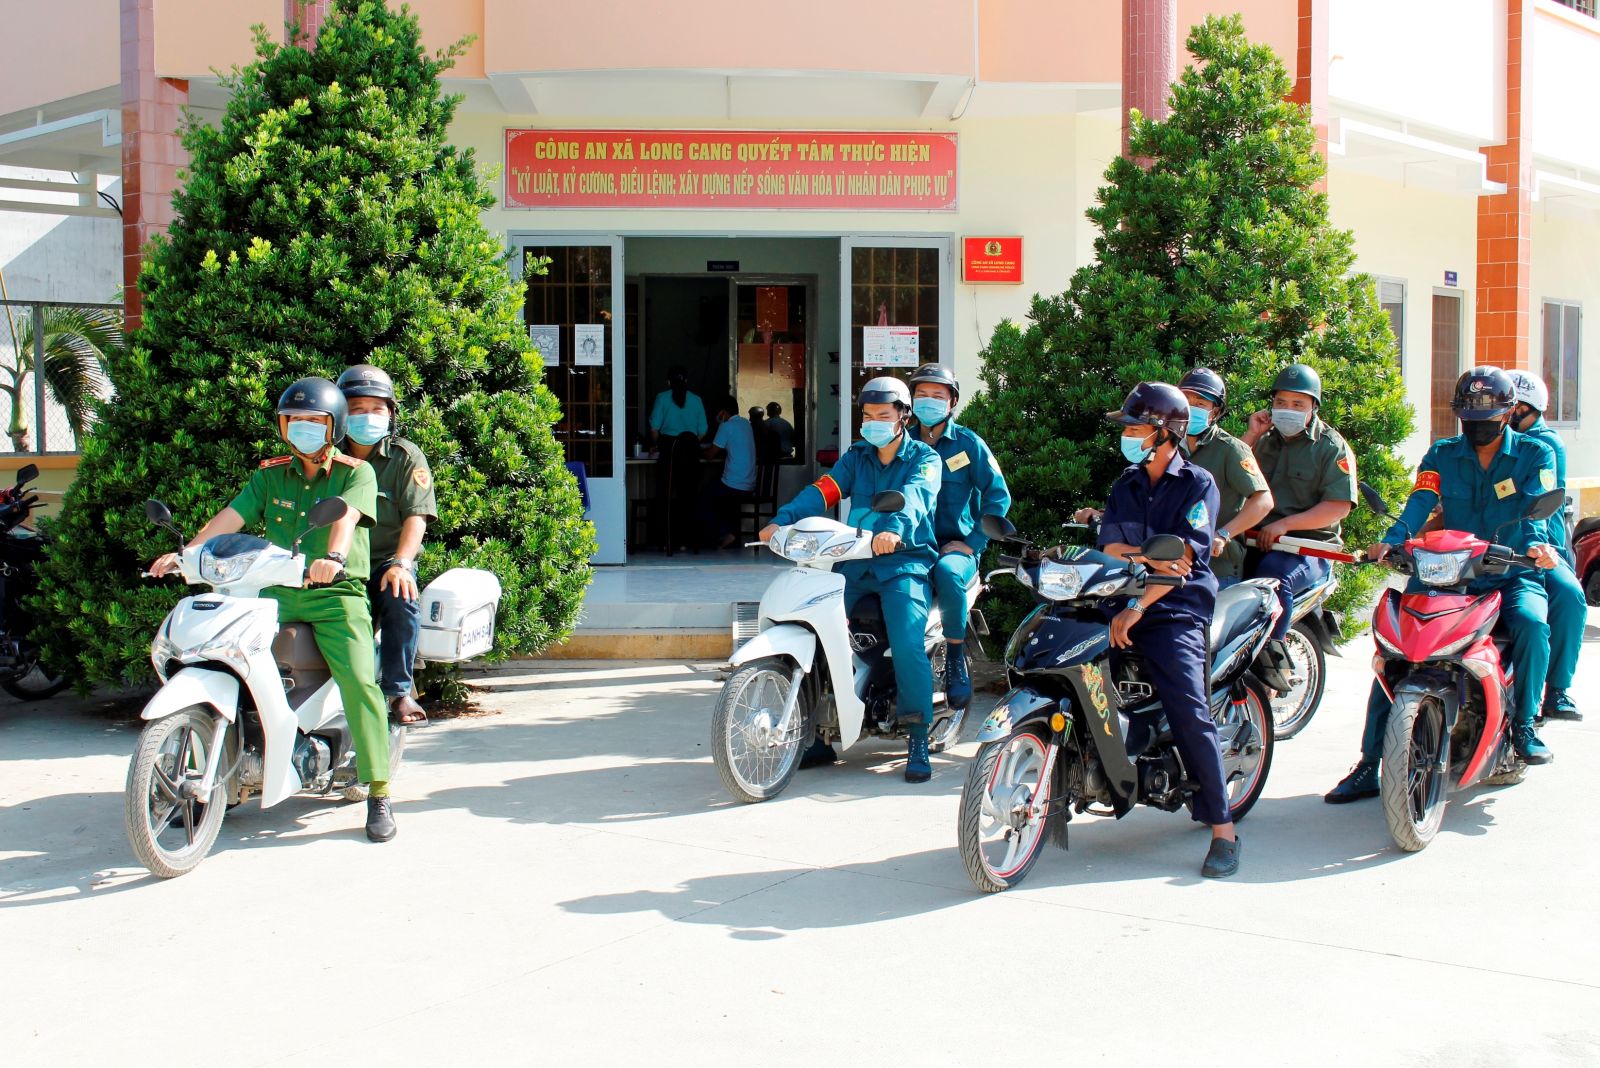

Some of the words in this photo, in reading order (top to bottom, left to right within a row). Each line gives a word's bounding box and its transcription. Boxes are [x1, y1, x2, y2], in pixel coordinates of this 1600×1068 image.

[535, 138, 579, 160] CÔNG
[585, 142, 607, 160] AN
[612, 138, 634, 160] XÃ
[640, 143, 683, 160] LONG
[689, 143, 732, 161] CANG
[737, 137, 792, 162] QUYẾT
[797, 139, 834, 161] TÂM
[840, 141, 885, 166] THỰC
[890, 141, 930, 166] HIỆN
[533, 168, 560, 198] LUẬT,
[563, 166, 577, 194] KỶ
[620, 166, 644, 194] ĐIỀU
[679, 169, 699, 194] XÂY
[702, 171, 730, 199] DỰNG
[733, 168, 754, 195] NẾP
[757, 167, 785, 195] SỐNG
[788, 170, 808, 196] VĂN
[812, 170, 833, 196] HÓA
[835, 170, 845, 195] VÌ
[848, 170, 876, 196] NHÂN
[880, 170, 901, 196] DÂN
[904, 175, 931, 200] PHỤC
